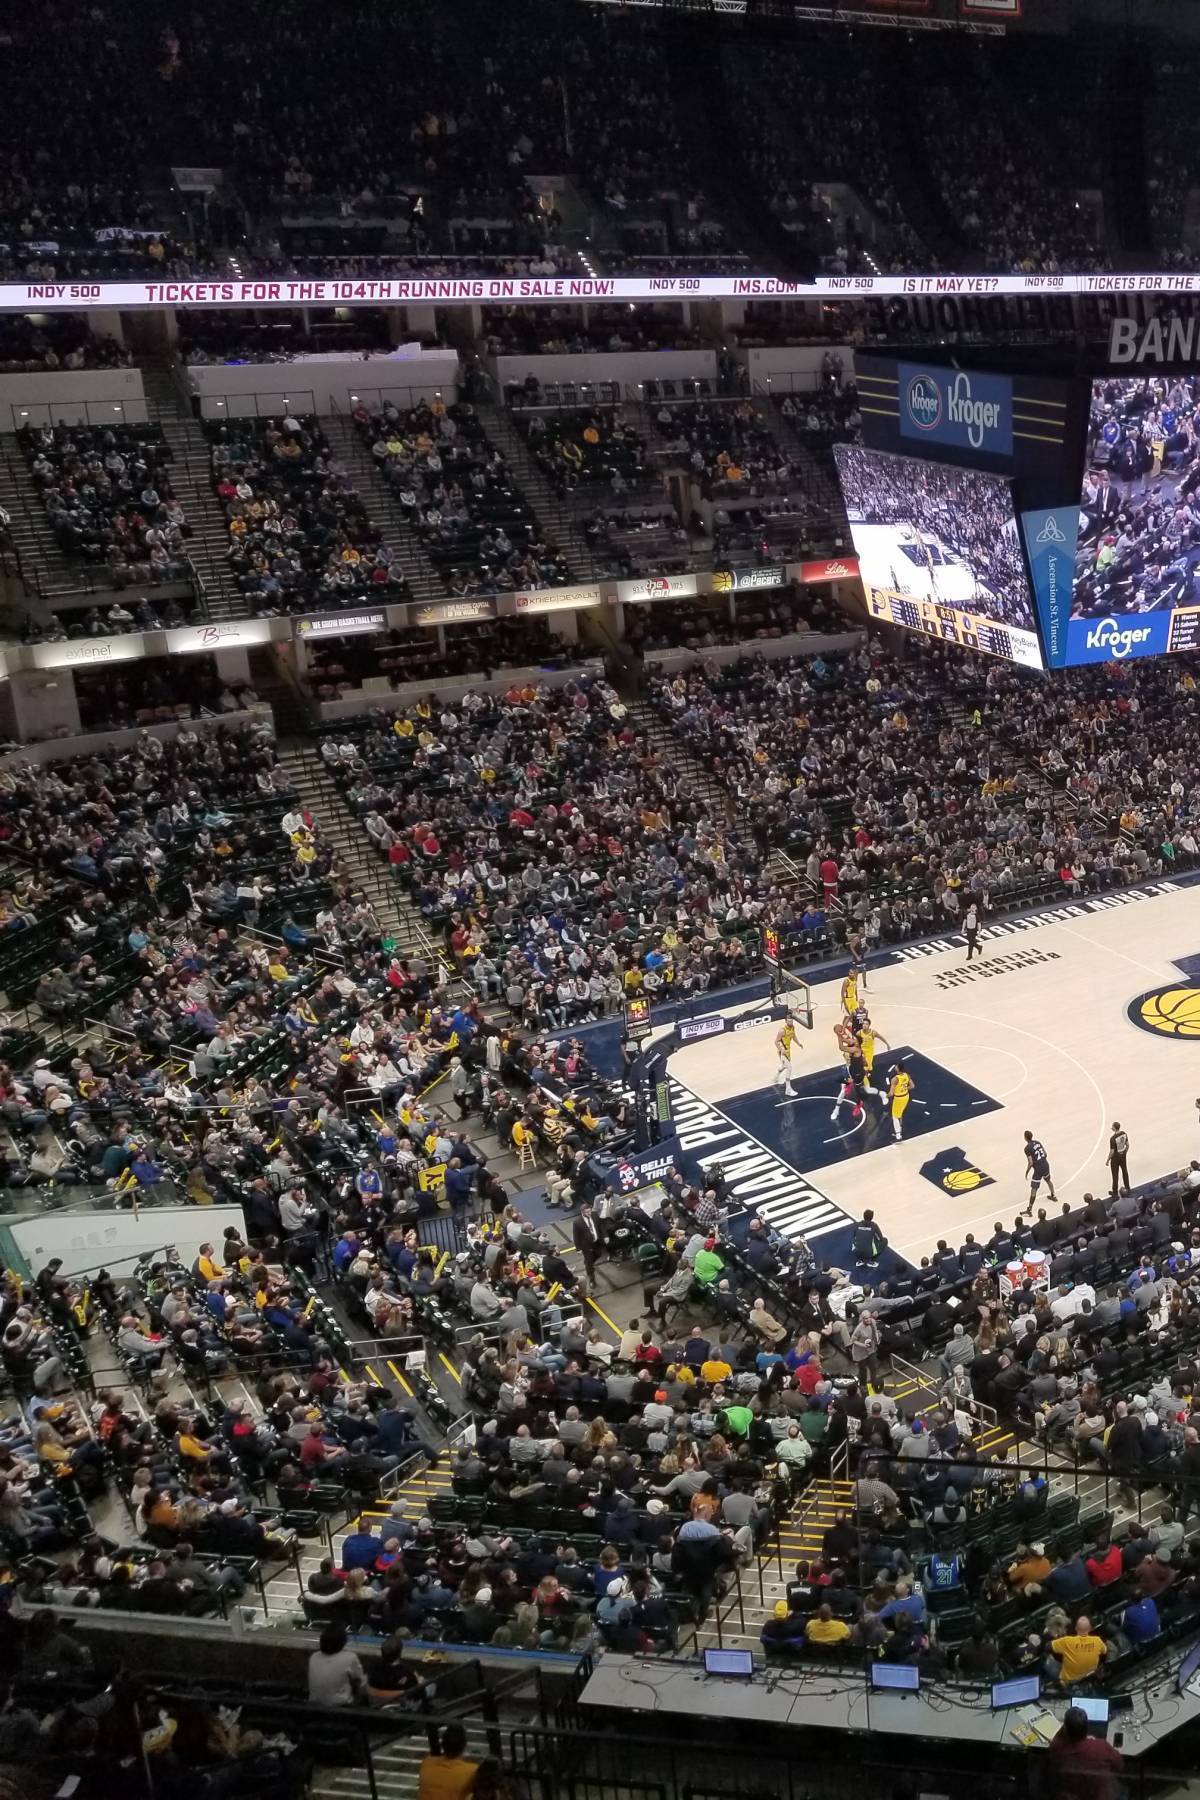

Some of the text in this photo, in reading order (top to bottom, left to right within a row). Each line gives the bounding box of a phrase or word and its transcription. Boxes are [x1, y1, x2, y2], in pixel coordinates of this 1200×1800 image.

[649, 279, 700, 290] INDY 500
[733, 280, 798, 293] IMS.COM
[828, 278, 873, 289] INDY 500
[903, 278, 998, 292] IS IT MAY YET?
[1024, 277, 1064, 287] INDY 500
[1087, 277, 1135, 290] TICKETS
[1138, 277, 1163, 289] FOR
[1166, 277, 1193, 289] THE
[27, 285, 100, 298] INDY 500
[145, 280, 614, 302] TICKETS FOR THE 104TH RUNNING ON SALE NOW!
[911, 384, 938, 426] Kroger
[948, 373, 1000, 448] Kroger
[825, 562, 848, 575] Lilly
[646, 579, 664, 590] the
[740, 575, 782, 586] @Pacers
[1048, 555, 1060, 656] Ascension St. Vincent
[312, 621, 321, 629] WE
[928, 622, 974, 645] 4 0
[1087, 618, 1151, 658] Kroger
[896, 881, 1184, 962] WE GROW HERE
[932, 948, 1042, 981] FIELDHOUSE
[934, 952, 1062, 991] BANKERS LIFE
[686, 1020, 720, 1033] INDY 500
[734, 1015, 772, 1031] GEICO
[1035, 1148, 1045, 1160] 23
[641, 1155, 674, 1174] BELLE
[696, 1139, 855, 1243] INDIANA
[936, 1568, 952, 1585] 21
